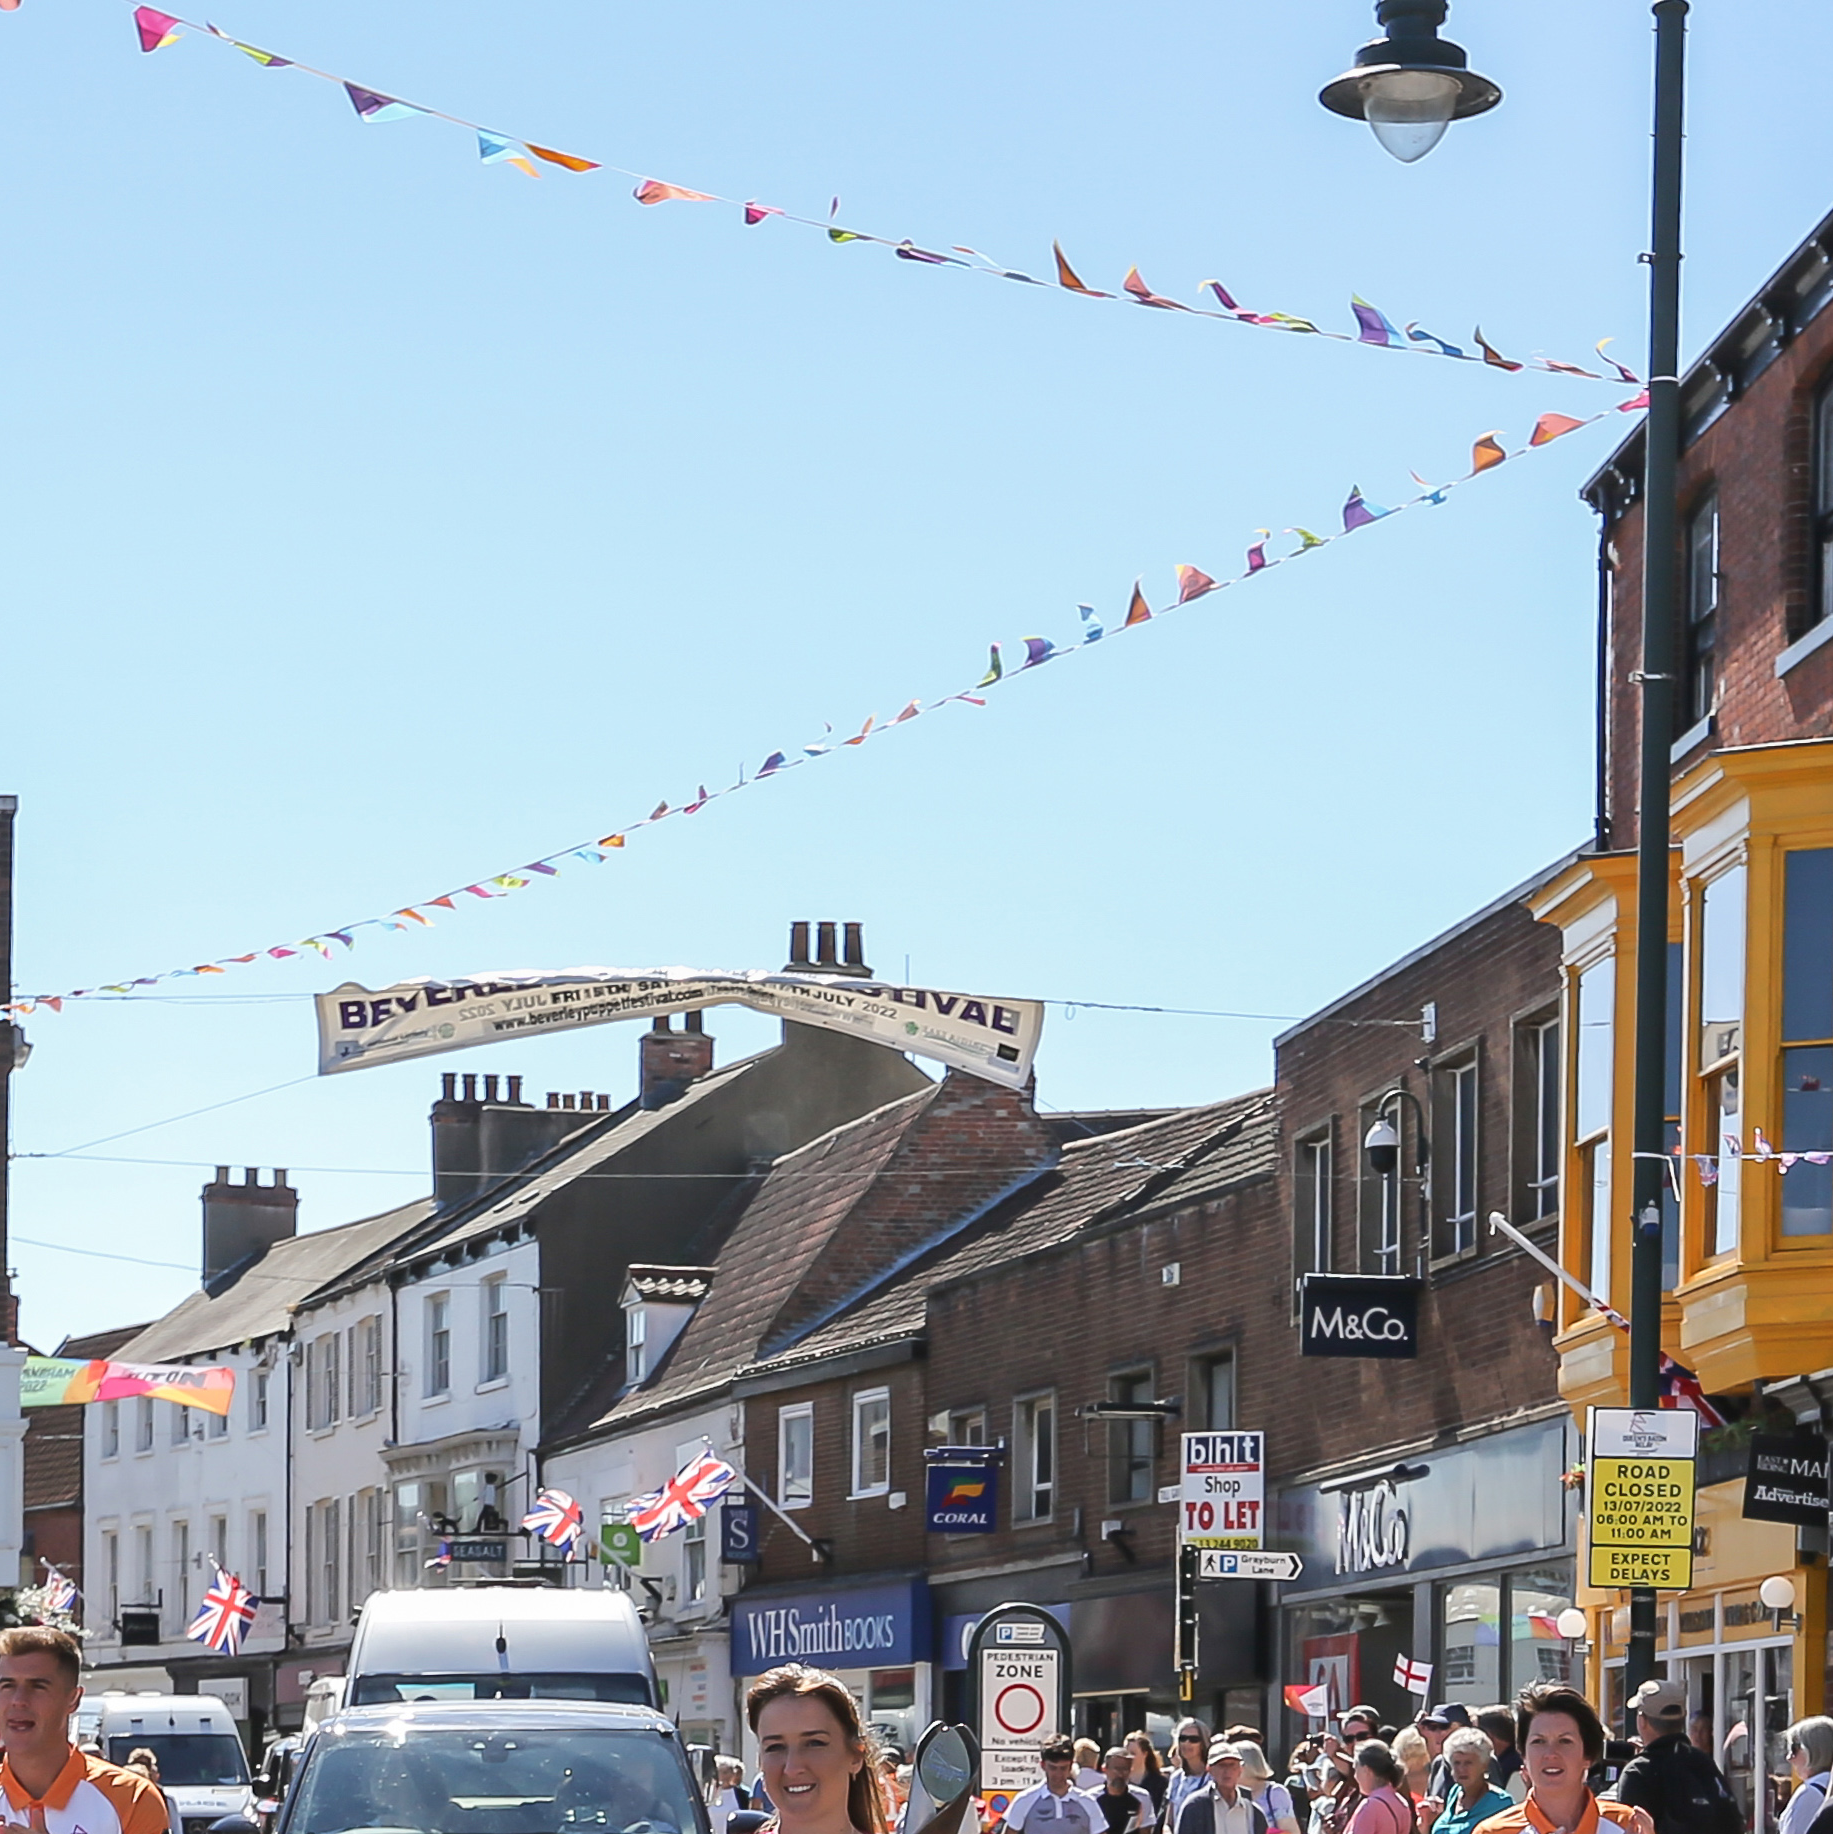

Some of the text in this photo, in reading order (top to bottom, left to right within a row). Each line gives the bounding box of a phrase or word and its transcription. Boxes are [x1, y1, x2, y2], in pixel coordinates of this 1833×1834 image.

[551, 988, 581, 1005] FRI
[812, 990, 856, 1007] JULY
[862, 1001, 898, 1020] 2022
[1311, 1306, 1408, 1340] M&Co.
[1618, 1465, 1670, 1479] ROAD
[1790, 1458, 1829, 1479] MAI
[1205, 1475, 1240, 1498] Shop
[1604, 1483, 1682, 1497] CLOSED
[1753, 1485, 1830, 1508] Advertise
[1604, 1501, 1681, 1513] 13/07/2022
[933, 1513, 987, 1524] CORAL
[1185, 1501, 1260, 1530] TO LET
[1596, 1515, 1687, 1526] 06:00 AM TO
[730, 1519, 749, 1548] S
[1611, 1528, 1671, 1539] 11:00 AM
[1241, 1555, 1286, 1565] Grayburn
[1612, 1553, 1671, 1565] EXPECT
[1252, 1566, 1274, 1574] Lane
[1610, 1568, 1670, 1581] DELAYS
[748, 1604, 894, 1660] WHSmith BOOKS
[987, 1652, 1054, 1662] PEDESTRIAN
[995, 1665, 1044, 1678] ZONE
[991, 1737, 1042, 1745] No vehicle
[994, 1754, 1040, 1763] Except fo
[1001, 1765, 1037, 1774] loading
